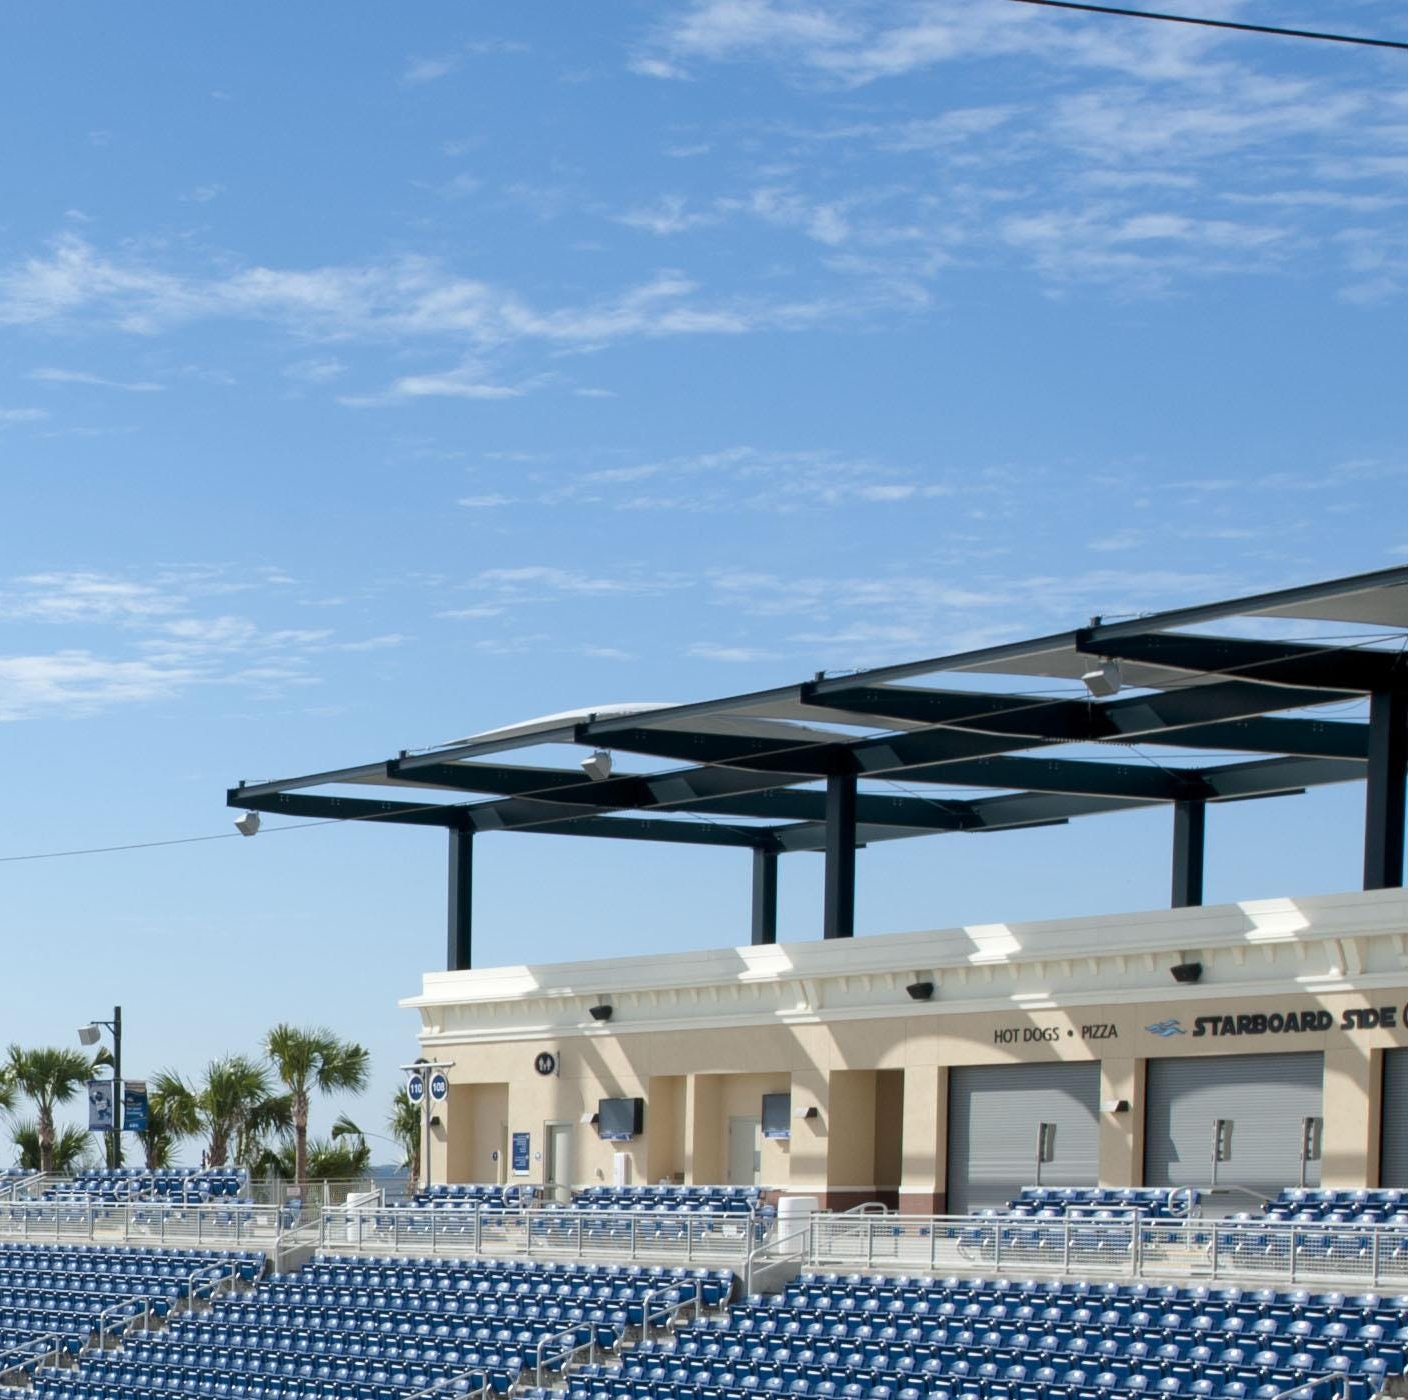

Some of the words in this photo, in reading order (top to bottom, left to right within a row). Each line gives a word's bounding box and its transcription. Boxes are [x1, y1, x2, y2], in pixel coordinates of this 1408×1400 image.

[1192, 1010, 1333, 1036] STARBOARD
[1340, 1007, 1397, 1031] SIDE
[994, 1028, 1020, 1044] HOT
[1023, 1026, 1060, 1043] DOGS
[1082, 1024, 1118, 1040] PIZZA
[410, 1084, 422, 1093] 110
